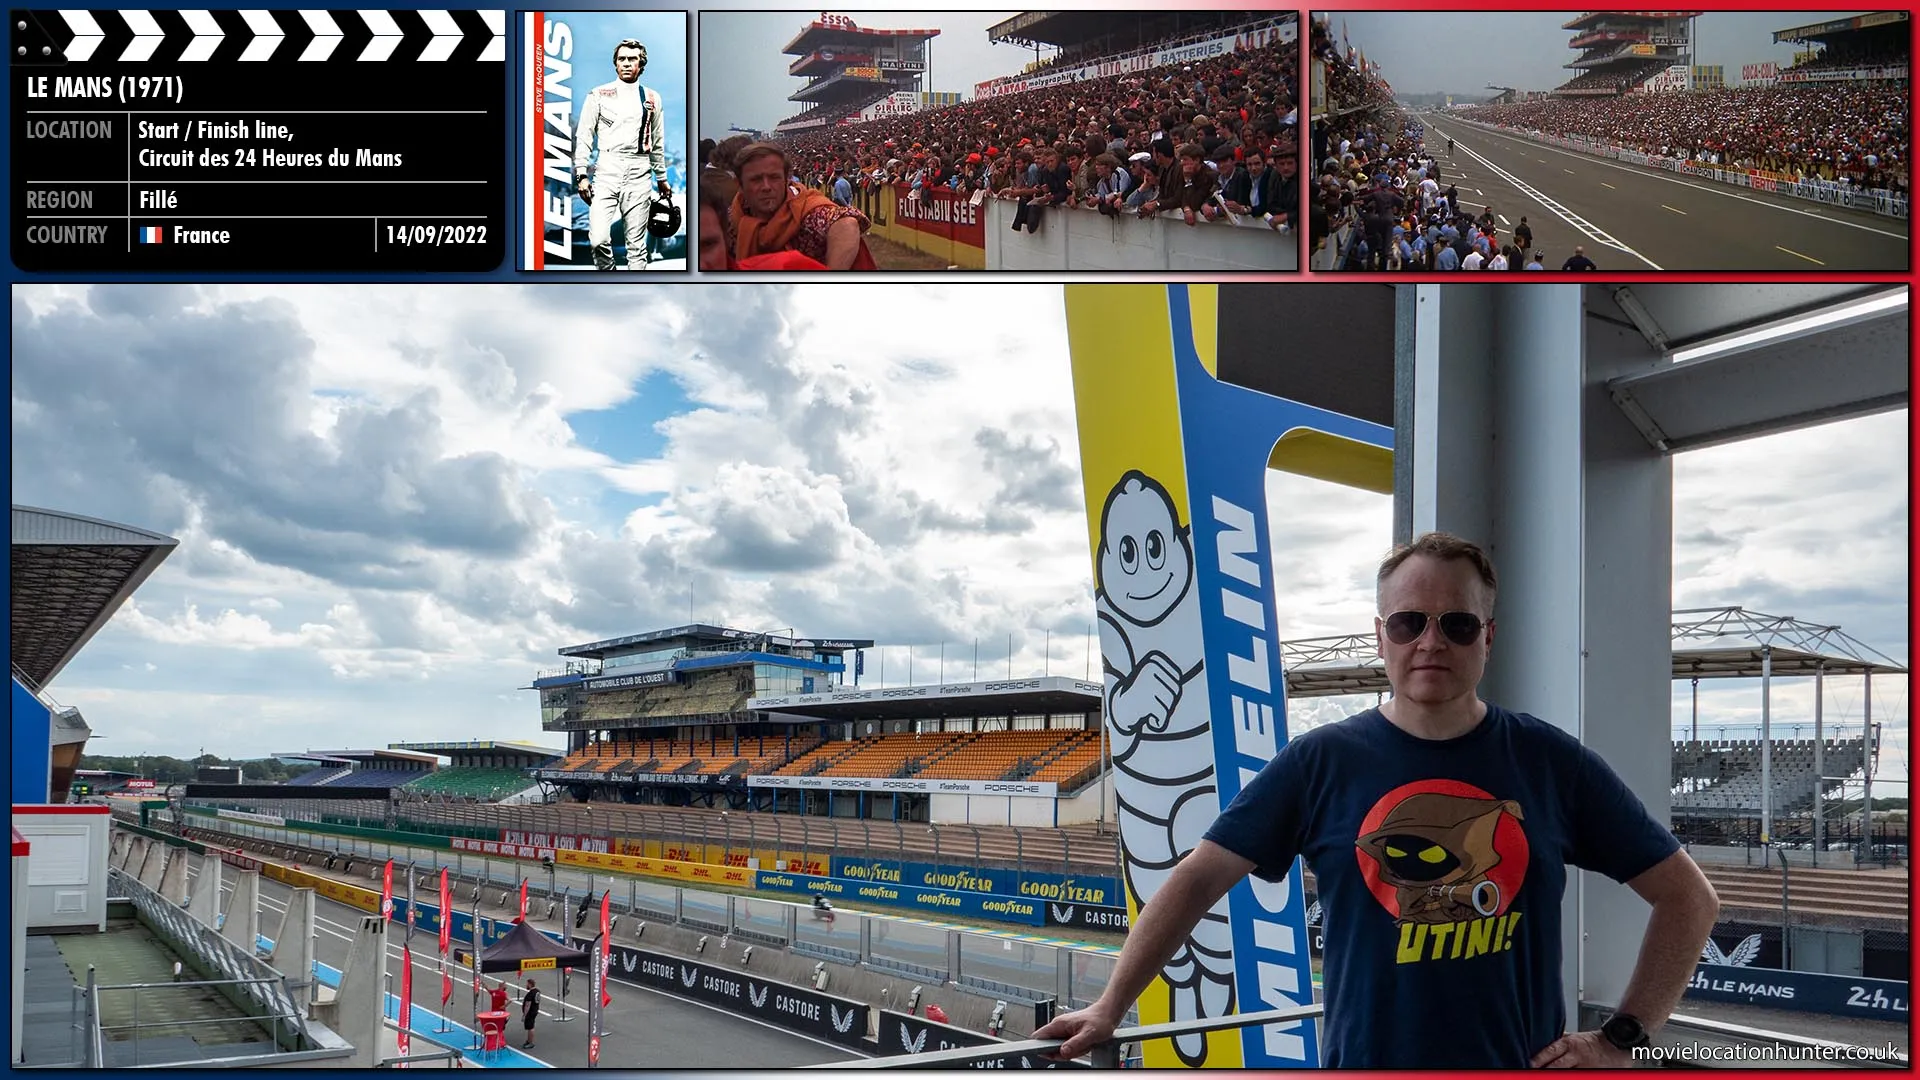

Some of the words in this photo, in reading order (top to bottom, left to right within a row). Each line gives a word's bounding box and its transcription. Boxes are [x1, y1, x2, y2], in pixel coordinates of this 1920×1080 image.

[820, 12, 850, 24] ESSO
[1160, 42, 1223, 64] BATTERIES
[882, 61, 921, 69] MARTINI
[1781, 73, 1807, 81] ANTAR
[998, 81, 1027, 96] ANTAR
[535, 86, 543, 114] STEVE
[543, 19, 574, 184] MANS
[1682, 164, 1713, 179] CHAMPION
[1786, 182, 1806, 197] Mbil
[1807, 185, 1830, 202] Mbil
[1831, 189, 1855, 207] Mbil
[1876, 197, 1905, 216] Mbil
[543, 190, 573, 261] LE
[590, 678, 620, 689] AUTOMOBILE
[620, 676, 634, 686] CLUB
[634, 675, 642, 684] DE
[643, 673, 664, 683] L'OUEST
[756, 697, 789, 706] PORSCHE
[832, 691, 872, 701] PORSCHE
[882, 688, 927, 697] PORSCHE
[985, 680, 1040, 691] PORSCHE
[128, 780, 154, 788] MOTUL
[832, 780, 871, 788] PORSCHE
[882, 781, 927, 789] PORSCHE
[984, 784, 1040, 793] PORSCHE
[1211, 494, 1306, 1062] MIELIN
[664, 864, 680, 874] DHL
[693, 867, 711, 878] DHL
[724, 871, 744, 881] DHL
[723, 853, 748, 867] DHL
[789, 859, 823, 875] DHL
[844, 863, 900, 883] GOODYEAR
[924, 870, 993, 892] GOODYEAR
[1020, 879, 1104, 904] GOODYEAR
[761, 875, 794, 887] GOODYEAR
[808, 880, 843, 893] GOODYEAR
[859, 886, 899, 899] GOODYEAR
[917, 893, 961, 907] GOODYEAR
[982, 900, 1034, 915] GOODYEAR
[1085, 911, 1129, 926] CASTOR
[1396, 911, 1523, 964] UTINI!
[642, 960, 674, 980] CASTORE
[703, 975, 740, 998] CASTORE
[775, 994, 821, 1022] CASTORE
[1712, 979, 1735, 992] LE
[1738, 982, 1795, 999] MANS
